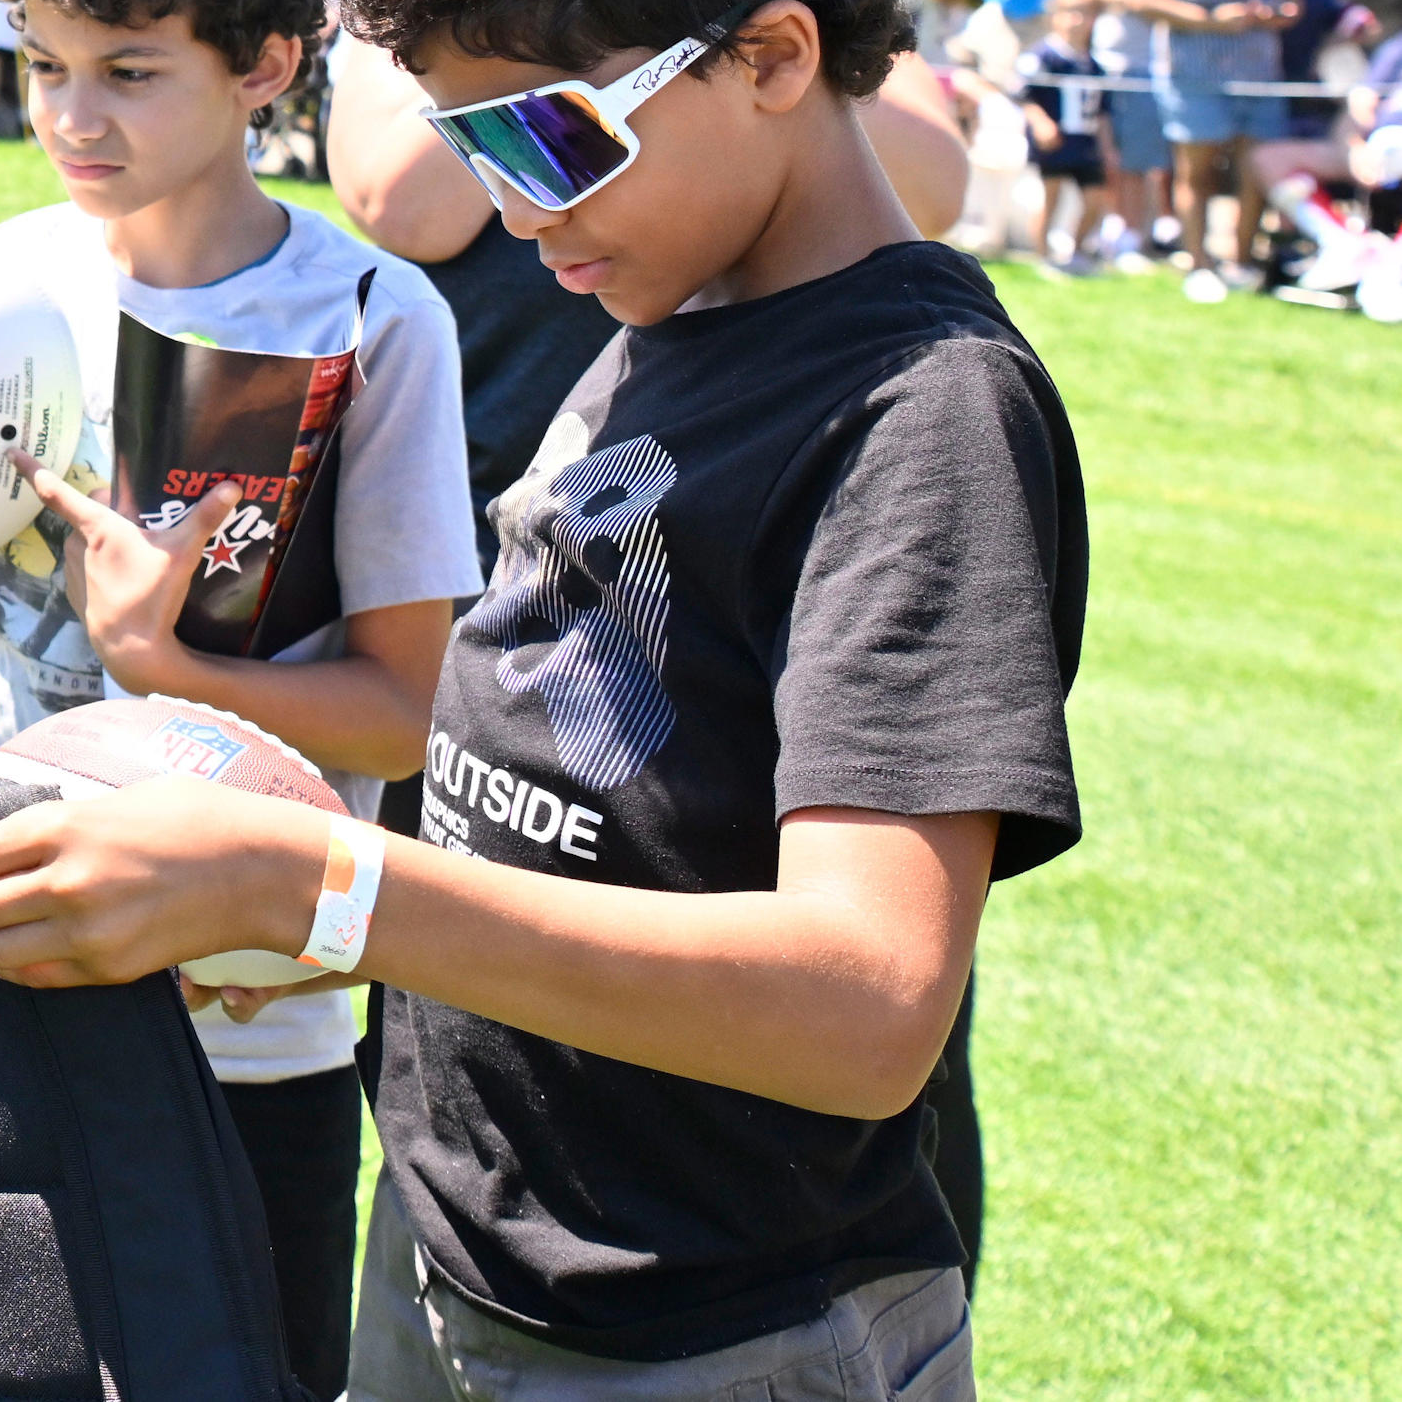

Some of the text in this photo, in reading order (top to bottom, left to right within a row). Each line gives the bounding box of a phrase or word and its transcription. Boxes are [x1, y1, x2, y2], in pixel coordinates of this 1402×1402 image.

[34, 406, 50, 458] Wilson
[162, 732, 216, 777] NFL
[431, 731, 604, 862] OUTSIDE
